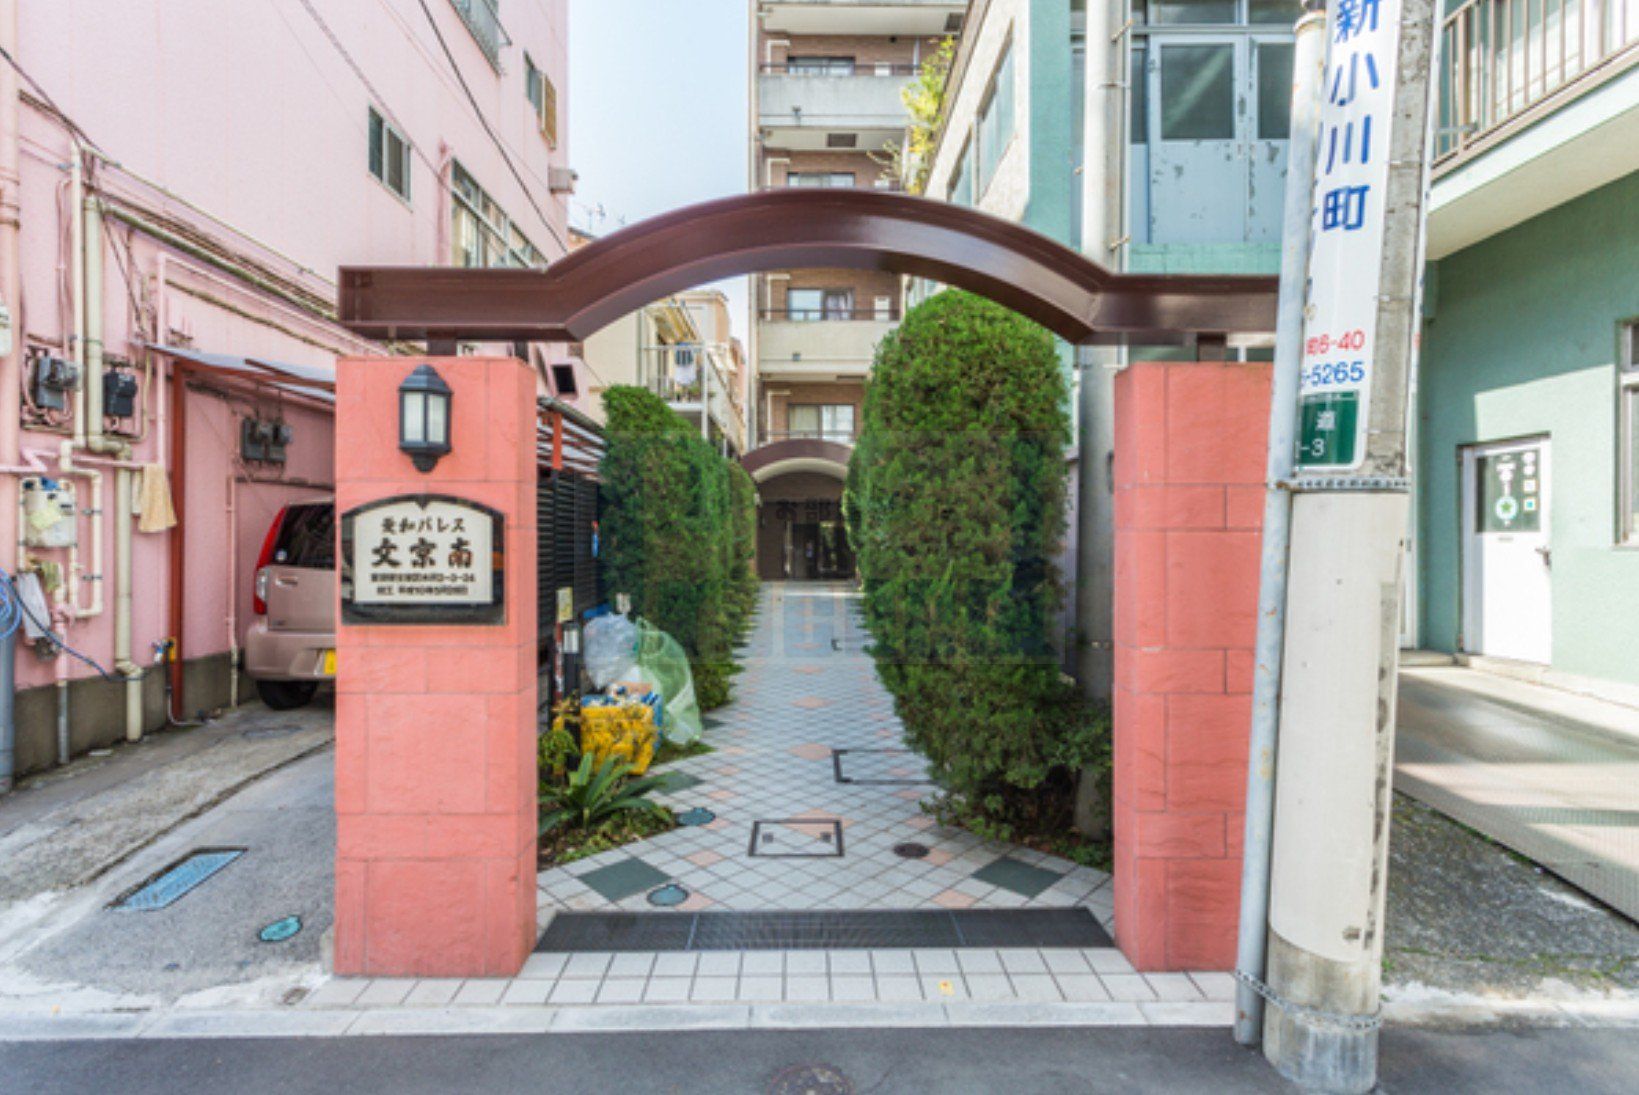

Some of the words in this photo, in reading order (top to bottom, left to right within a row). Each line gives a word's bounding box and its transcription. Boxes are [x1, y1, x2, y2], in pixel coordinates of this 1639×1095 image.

[1321, 0, 1380, 231] 新小川町
[371, 537, 473, 569] 文京南
